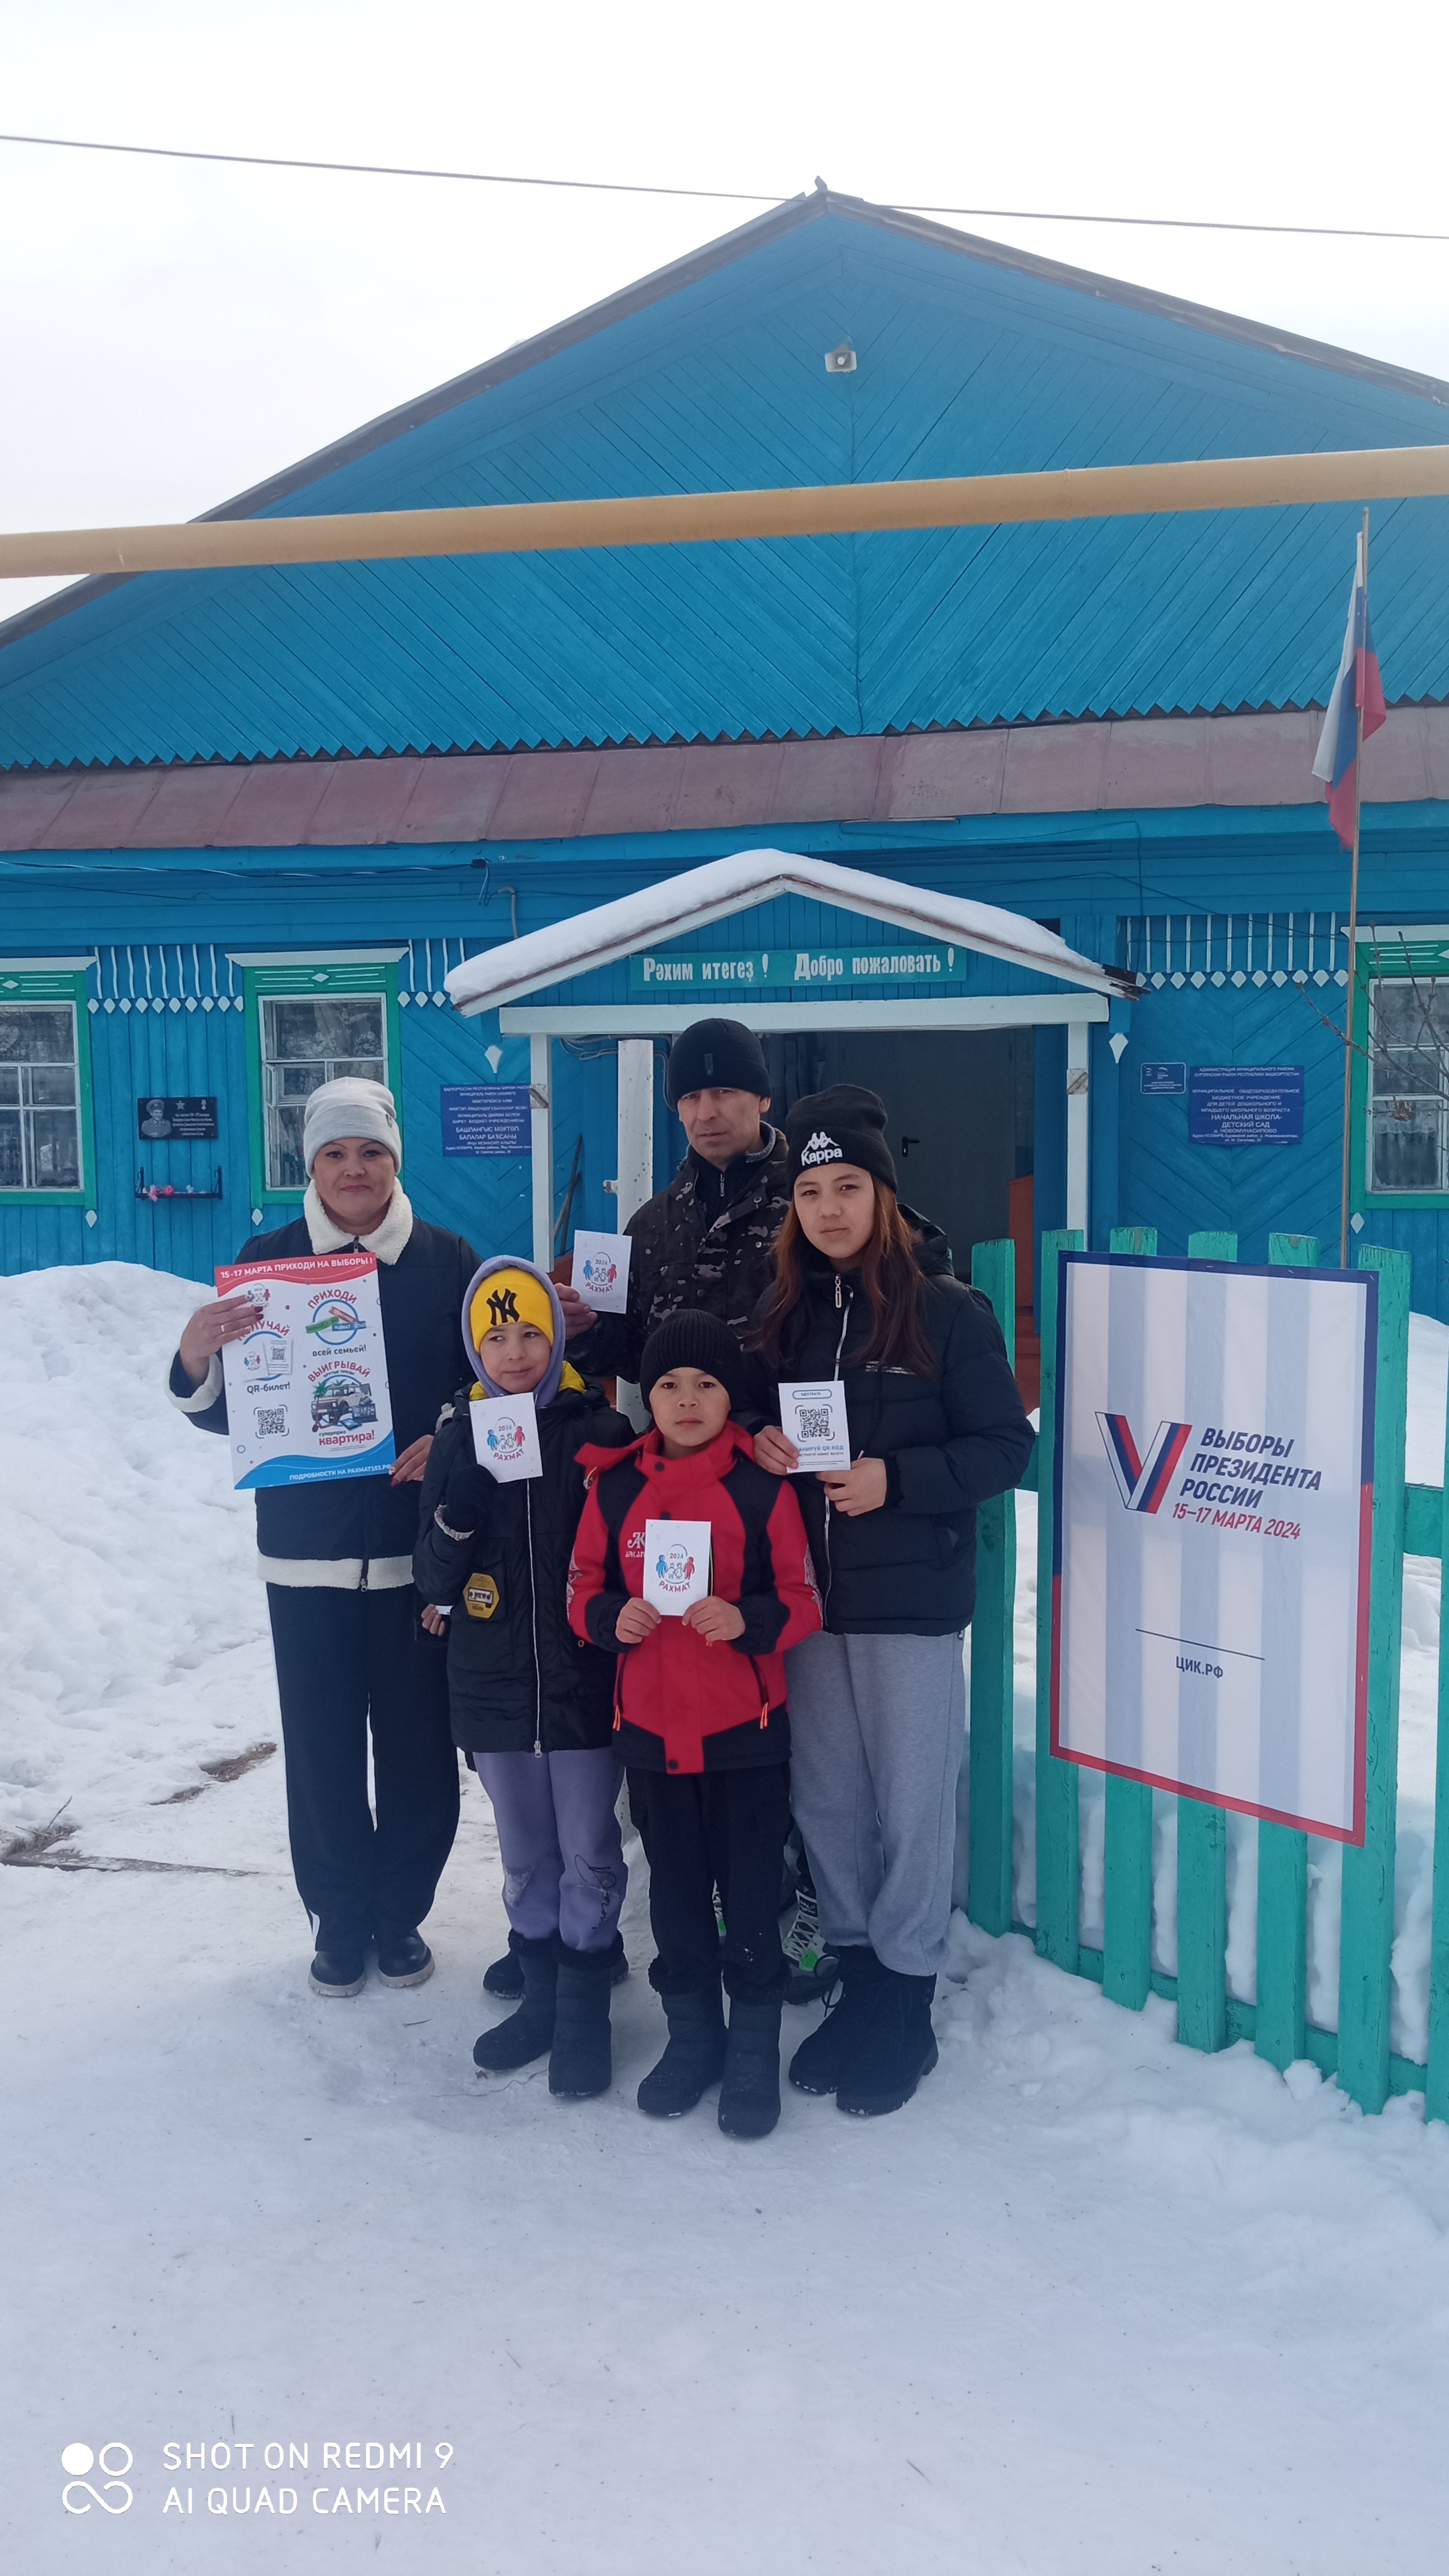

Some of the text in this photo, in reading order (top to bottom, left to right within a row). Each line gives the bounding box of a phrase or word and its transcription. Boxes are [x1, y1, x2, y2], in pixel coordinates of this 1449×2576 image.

[643, 953, 769, 982] Рәхим итегеҙ !
[794, 947, 955, 981] Добро пожаловать !
[801, 1148, 843, 1166] Kappa
[244, 1265, 273, 1275] МАРТА
[274, 1262, 316, 1272] ПРИХОДИ
[331, 1257, 368, 1267] ВЫБОРЫ
[586, 1282, 613, 1293] РАХМАТ
[308, 1289, 357, 1309] ПРИХОДИ
[486, 1288, 520, 1326] NY
[313, 1348, 332, 1357] всей
[308, 1361, 371, 1382] ВЫИГРЫВАЙ
[247, 1382, 291, 1394] QR-билет!
[319, 1430, 375, 1446] квартира!
[1200, 1427, 1294, 1458] ВЫБОРЫ
[494, 1448, 524, 1461] РАХМАТ
[289, 1470, 336, 1480] ПОДРОБНОСТИ
[1189, 1453, 1323, 1491] ПРЕЗИДЕНТА
[1179, 1478, 1264, 1509] РОССИИ
[1211, 1511, 1262, 1533] МАРТА
[1263, 1518, 1301, 1540] 2024
[658, 1580, 691, 1592] РАХМАТ
[1176, 1656, 1223, 1679] ЦИК.РФ
